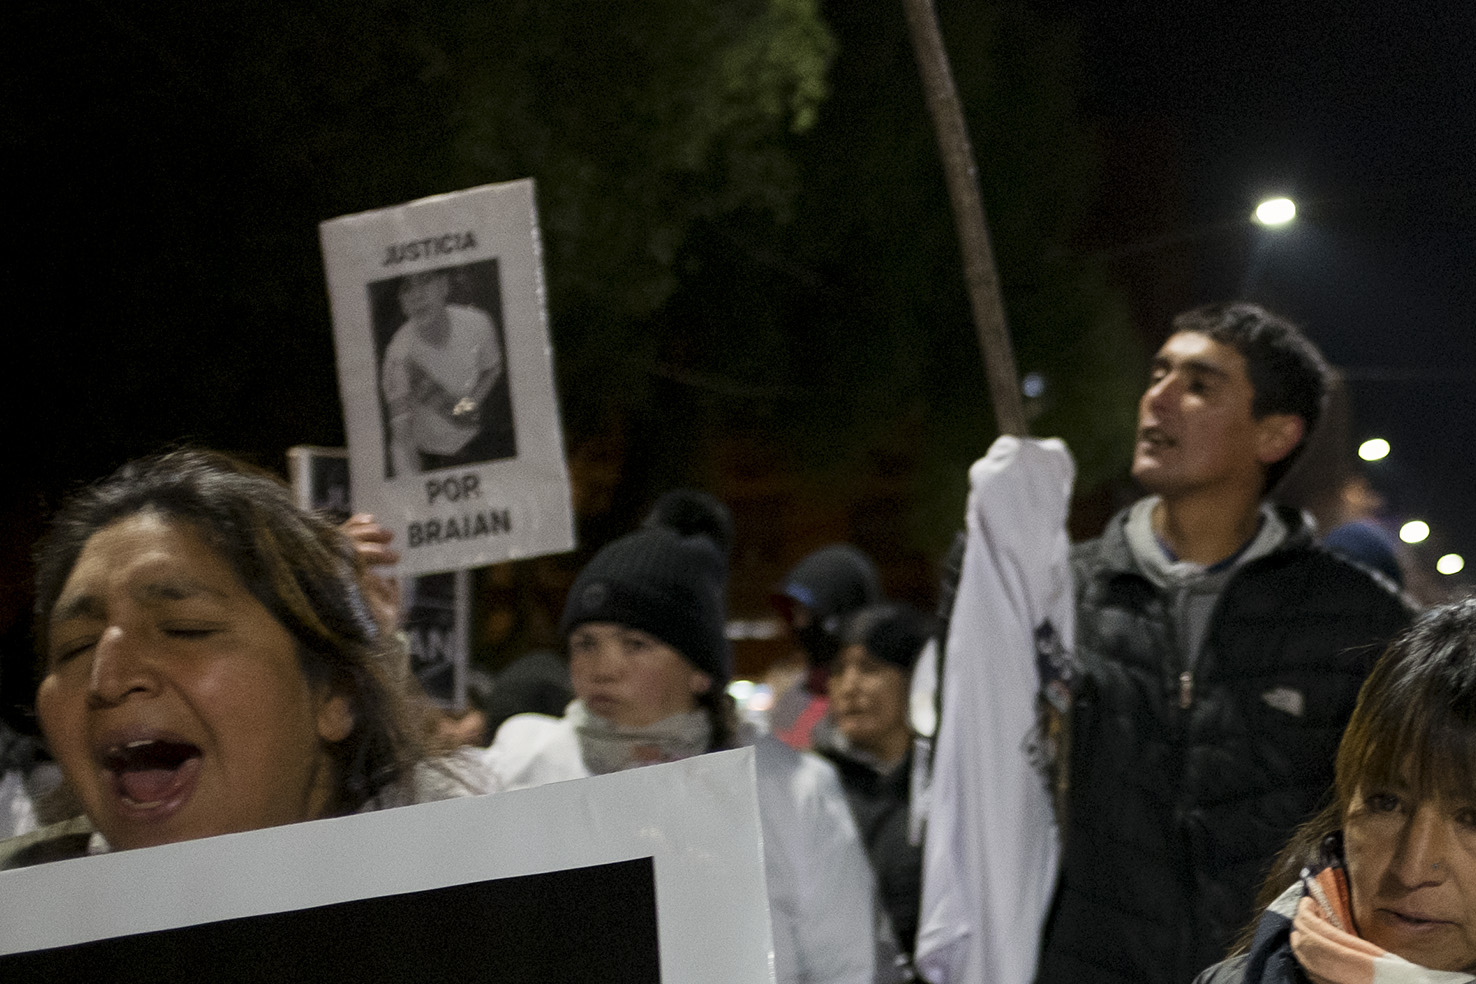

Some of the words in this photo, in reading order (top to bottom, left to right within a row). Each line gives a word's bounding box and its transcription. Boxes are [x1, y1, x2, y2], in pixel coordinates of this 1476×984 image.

[382, 230, 478, 267] JUSTICIA
[425, 474, 482, 505] POR
[407, 508, 512, 548] BRAIAN
